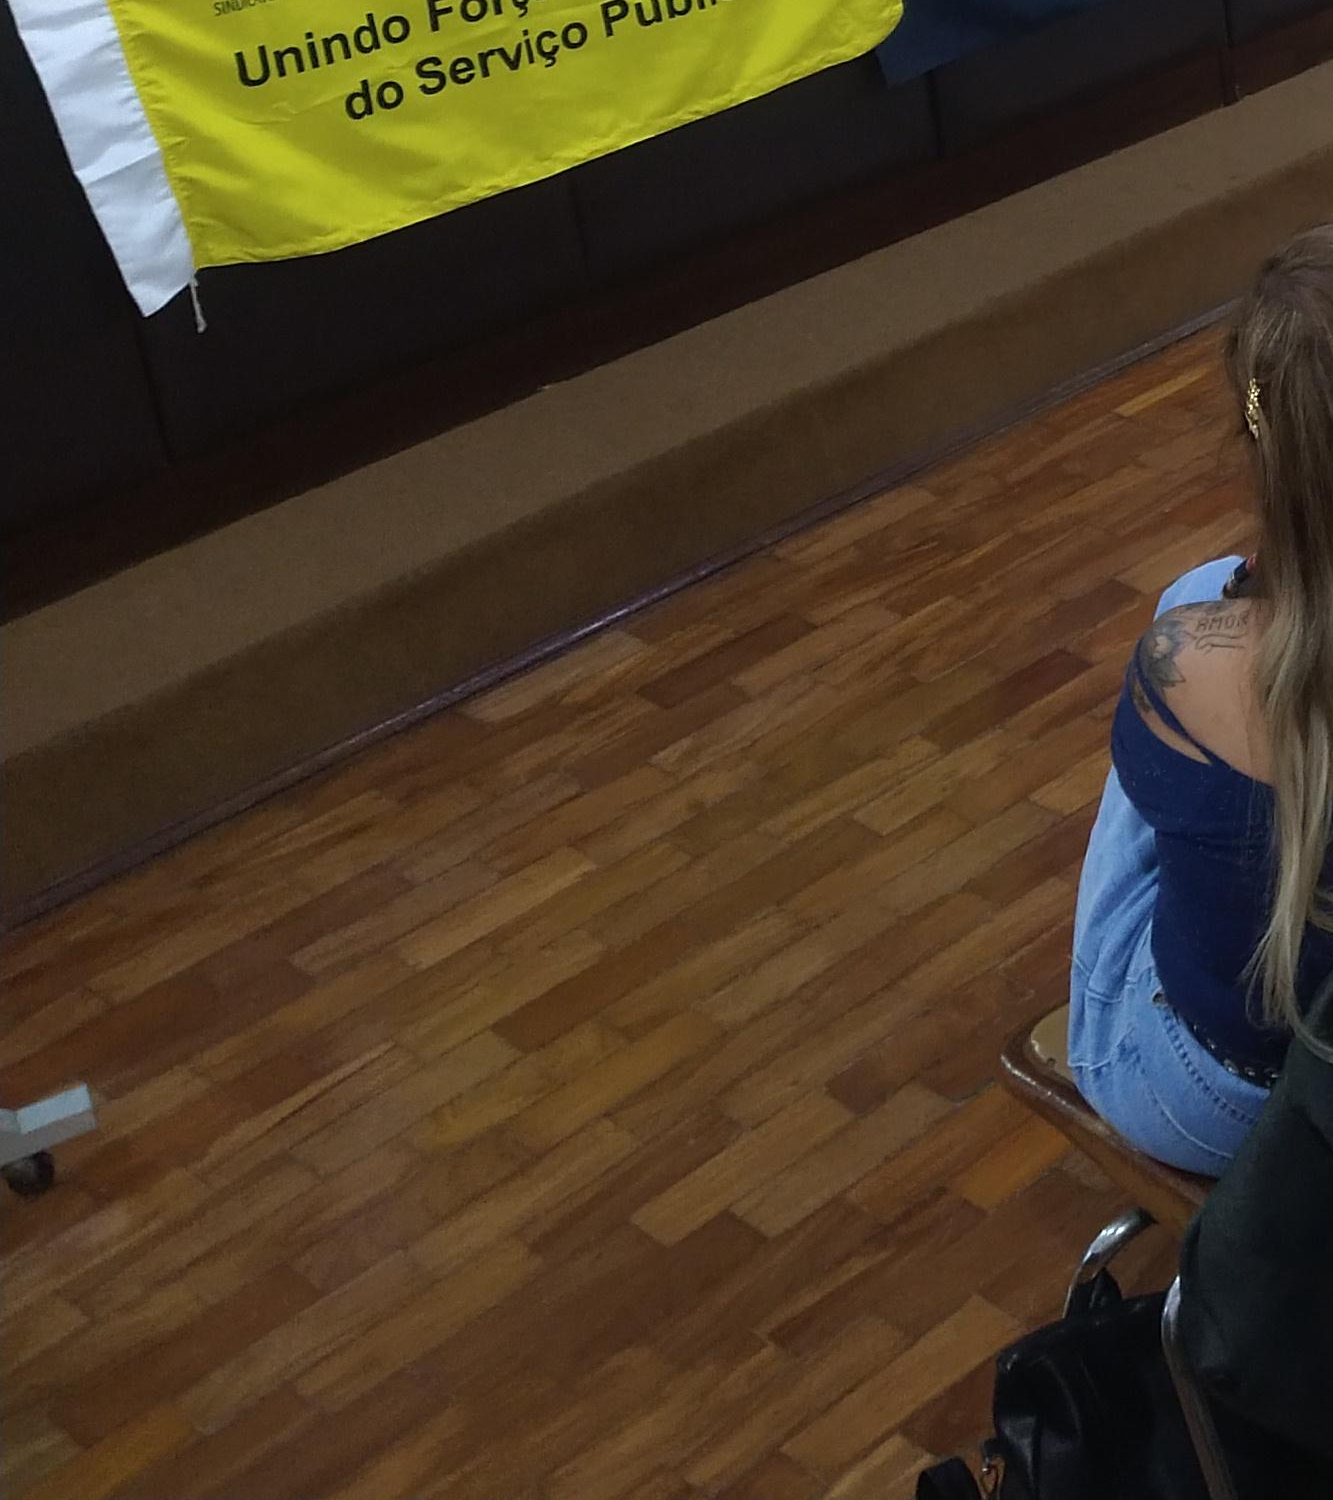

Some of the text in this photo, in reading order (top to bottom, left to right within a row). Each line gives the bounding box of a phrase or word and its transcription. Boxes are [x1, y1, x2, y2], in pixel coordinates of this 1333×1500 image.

[235, 12, 410, 87] Unindo
[345, 79, 404, 120] do
[415, 22, 588, 95] Serviço
